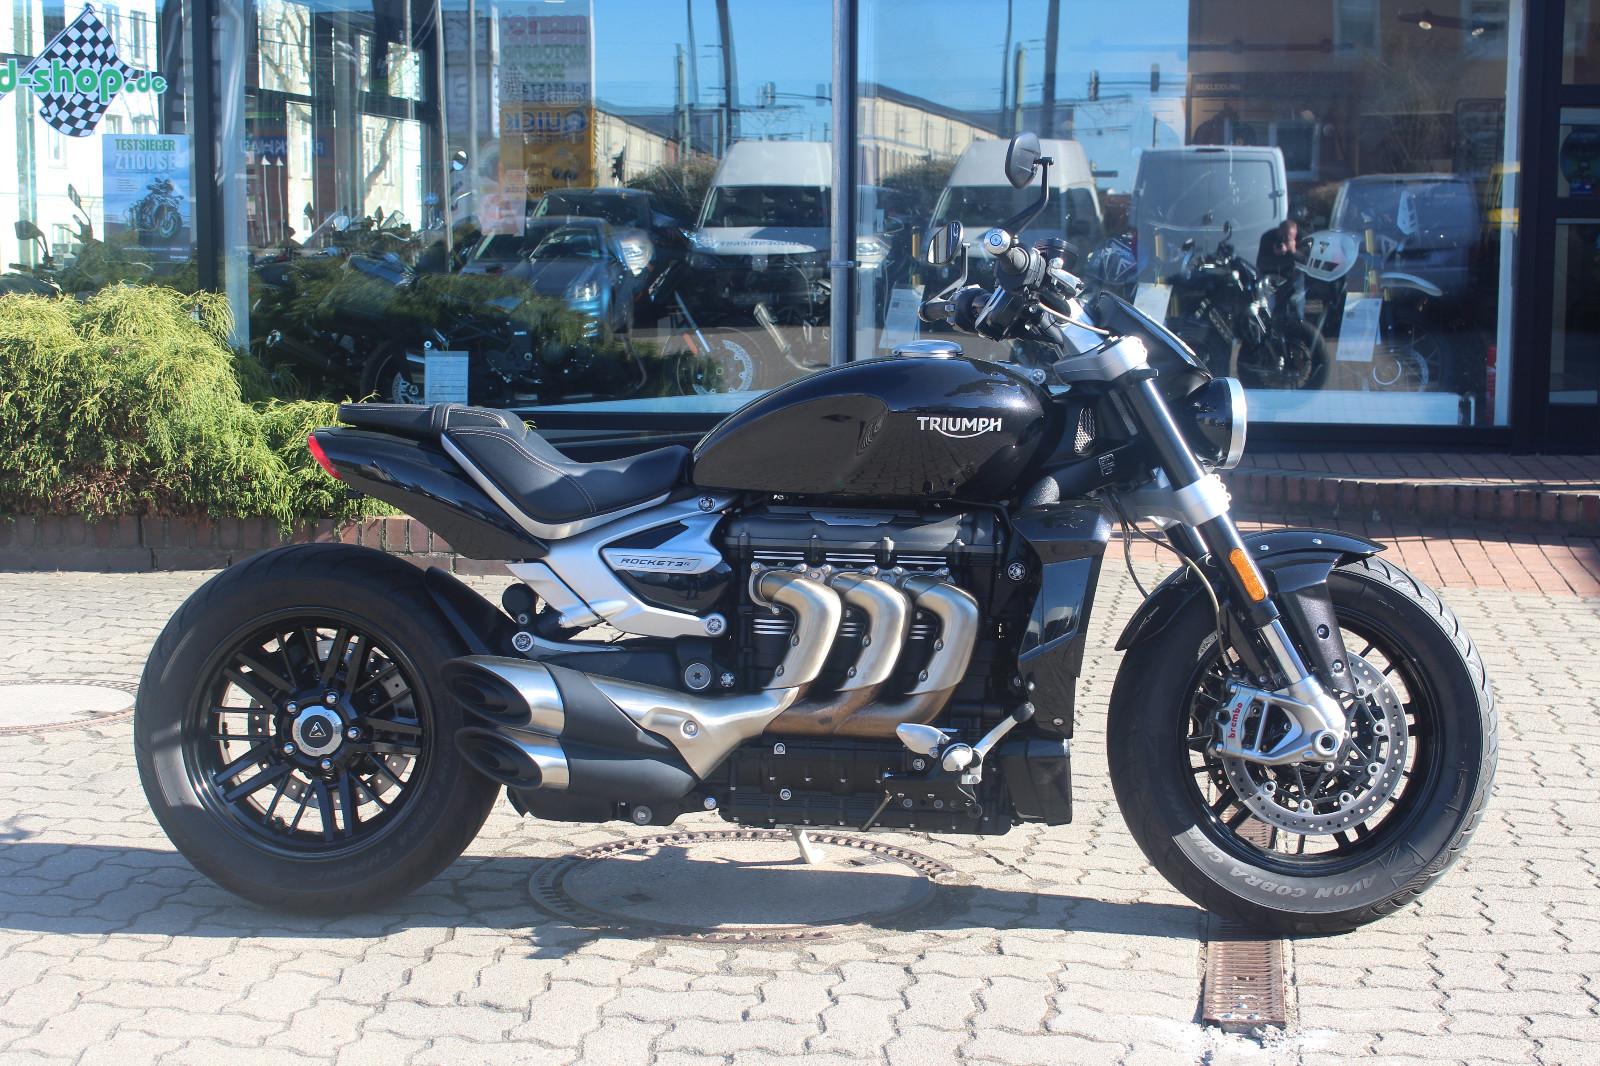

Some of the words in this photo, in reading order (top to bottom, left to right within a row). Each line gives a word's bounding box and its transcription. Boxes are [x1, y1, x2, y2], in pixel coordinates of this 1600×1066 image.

[115, 139, 176, 151] TESTSIEGER
[115, 153, 153, 170] Z1100
[916, 416, 1003, 438] TRIUMPH
[1228, 702, 1243, 739] brembo
[1229, 866, 1307, 899] COBRA
[1313, 873, 1378, 900] AVON
